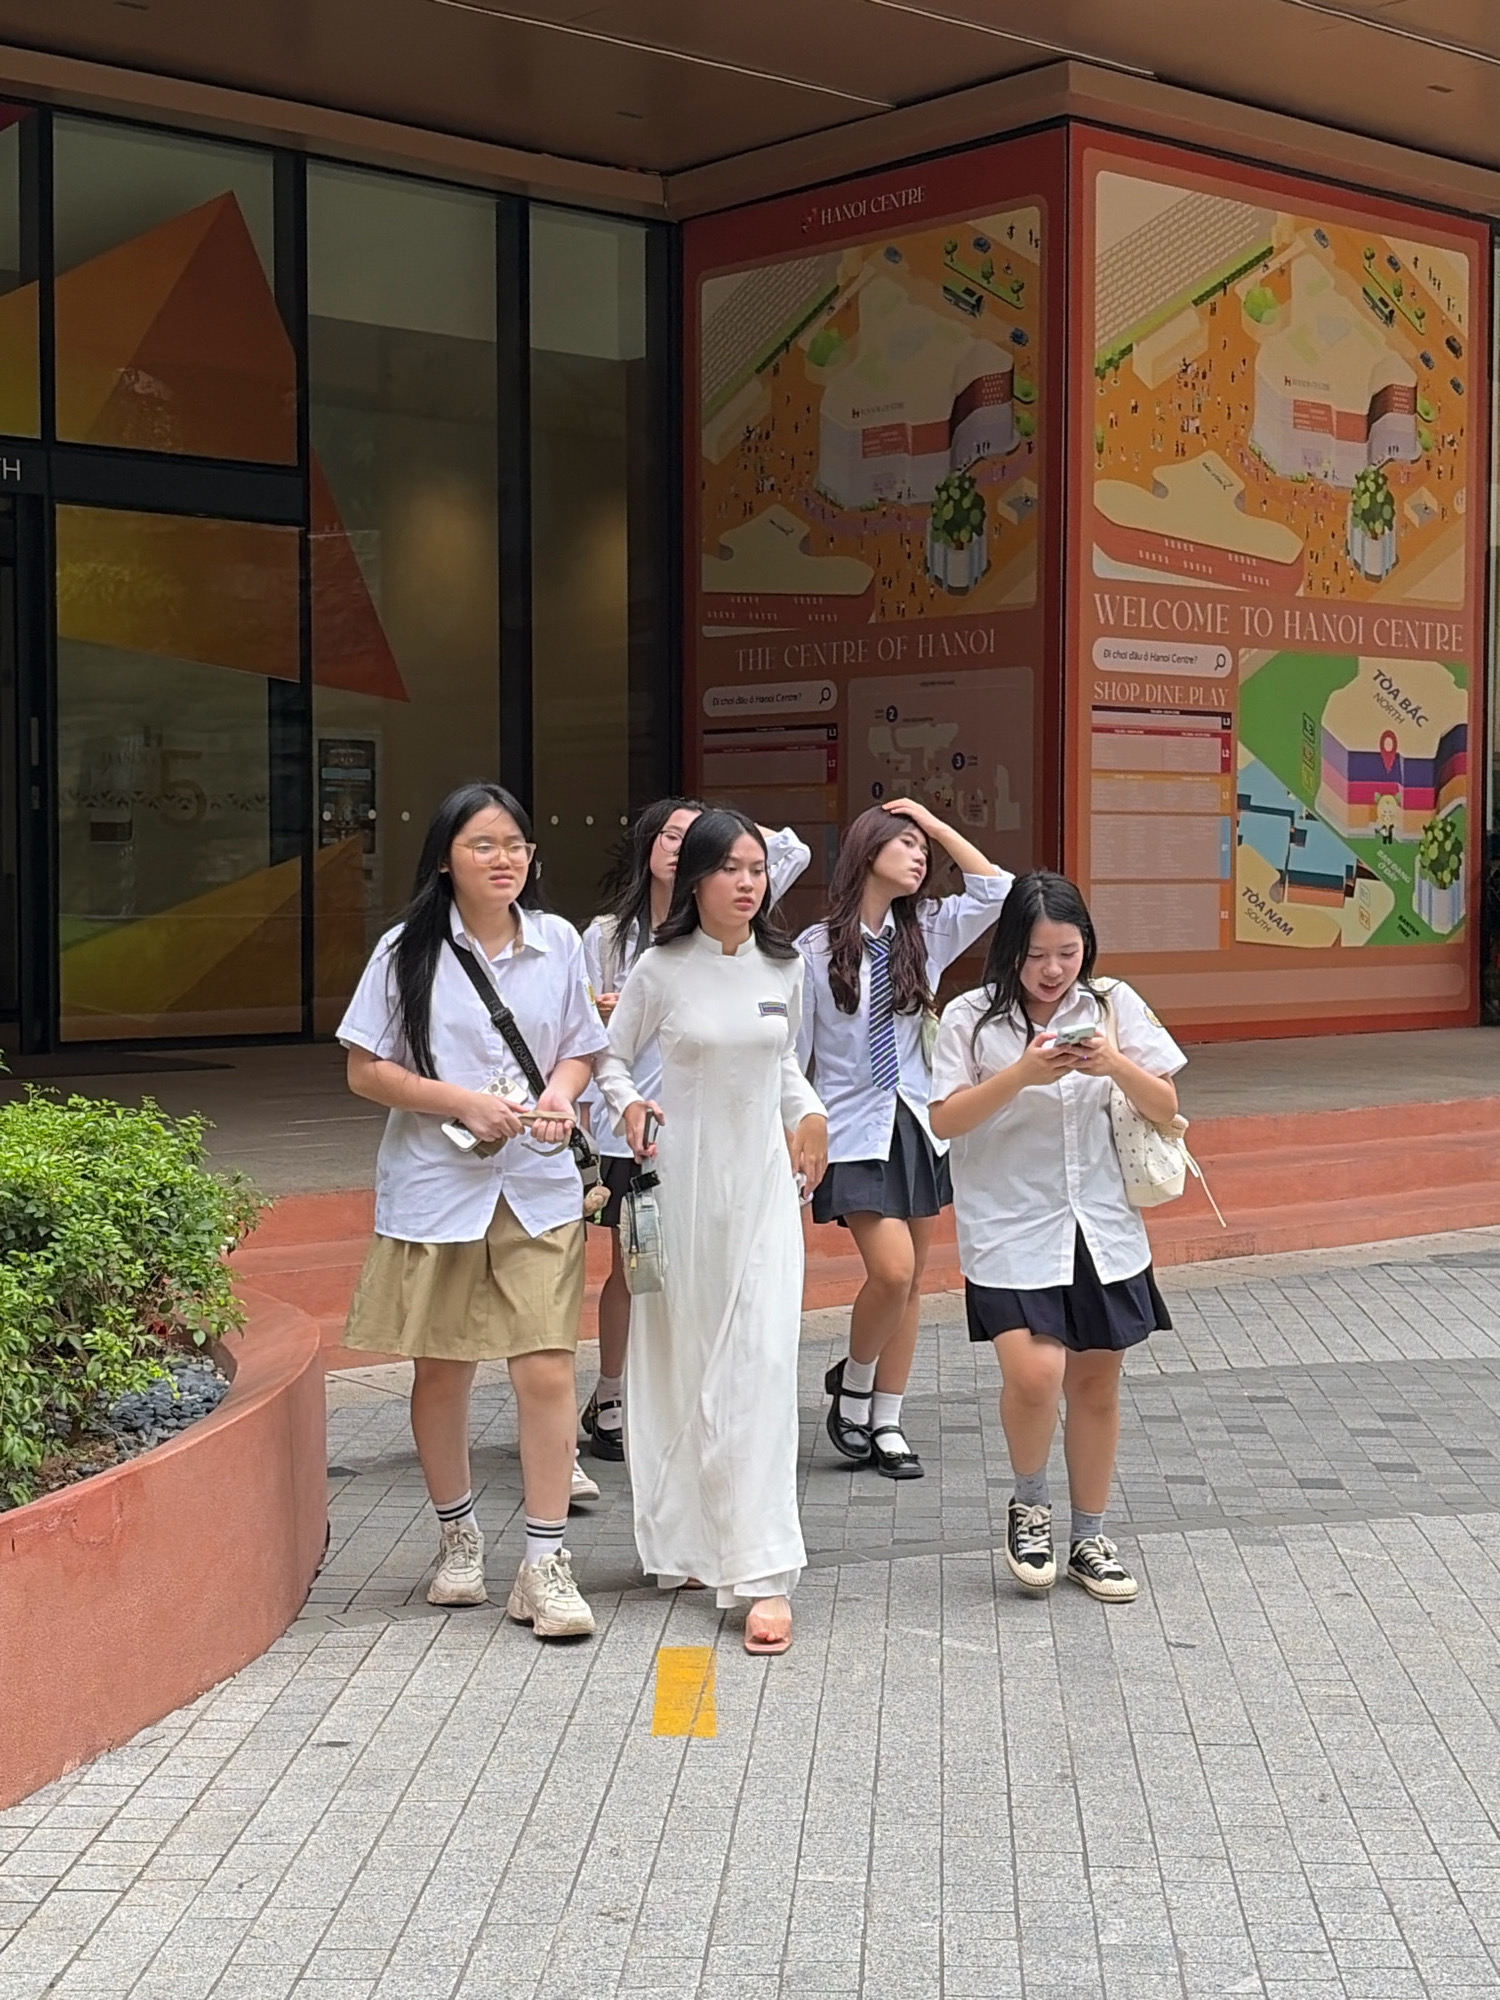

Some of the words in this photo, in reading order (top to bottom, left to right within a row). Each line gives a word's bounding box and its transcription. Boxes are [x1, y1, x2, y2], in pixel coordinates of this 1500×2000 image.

[821, 199, 867, 226] HANOI
[870, 185, 926, 213] CENTRE
[0, 456, 21, 482] H
[1093, 592, 1230, 635] WELCOME
[1240, 605, 1273, 638] TO
[1283, 609, 1364, 645] HANOI
[1373, 617, 1464, 653] CENTRE
[736, 647, 776, 672] THE
[784, 639, 870, 669] CENTRE
[878, 635, 908, 661] OF
[918, 628, 996, 659] HANOI
[1150, 651, 1171, 663] Hanoi
[1372, 668, 1400, 701] TÒA
[1373, 692, 1405, 725] NORTH
[1242, 886, 1266, 912] TÒA
[1264, 908, 1294, 936] NAM
[1244, 907, 1272, 932] SOUTH
[512, 1039, 536, 1075] YOUNG
